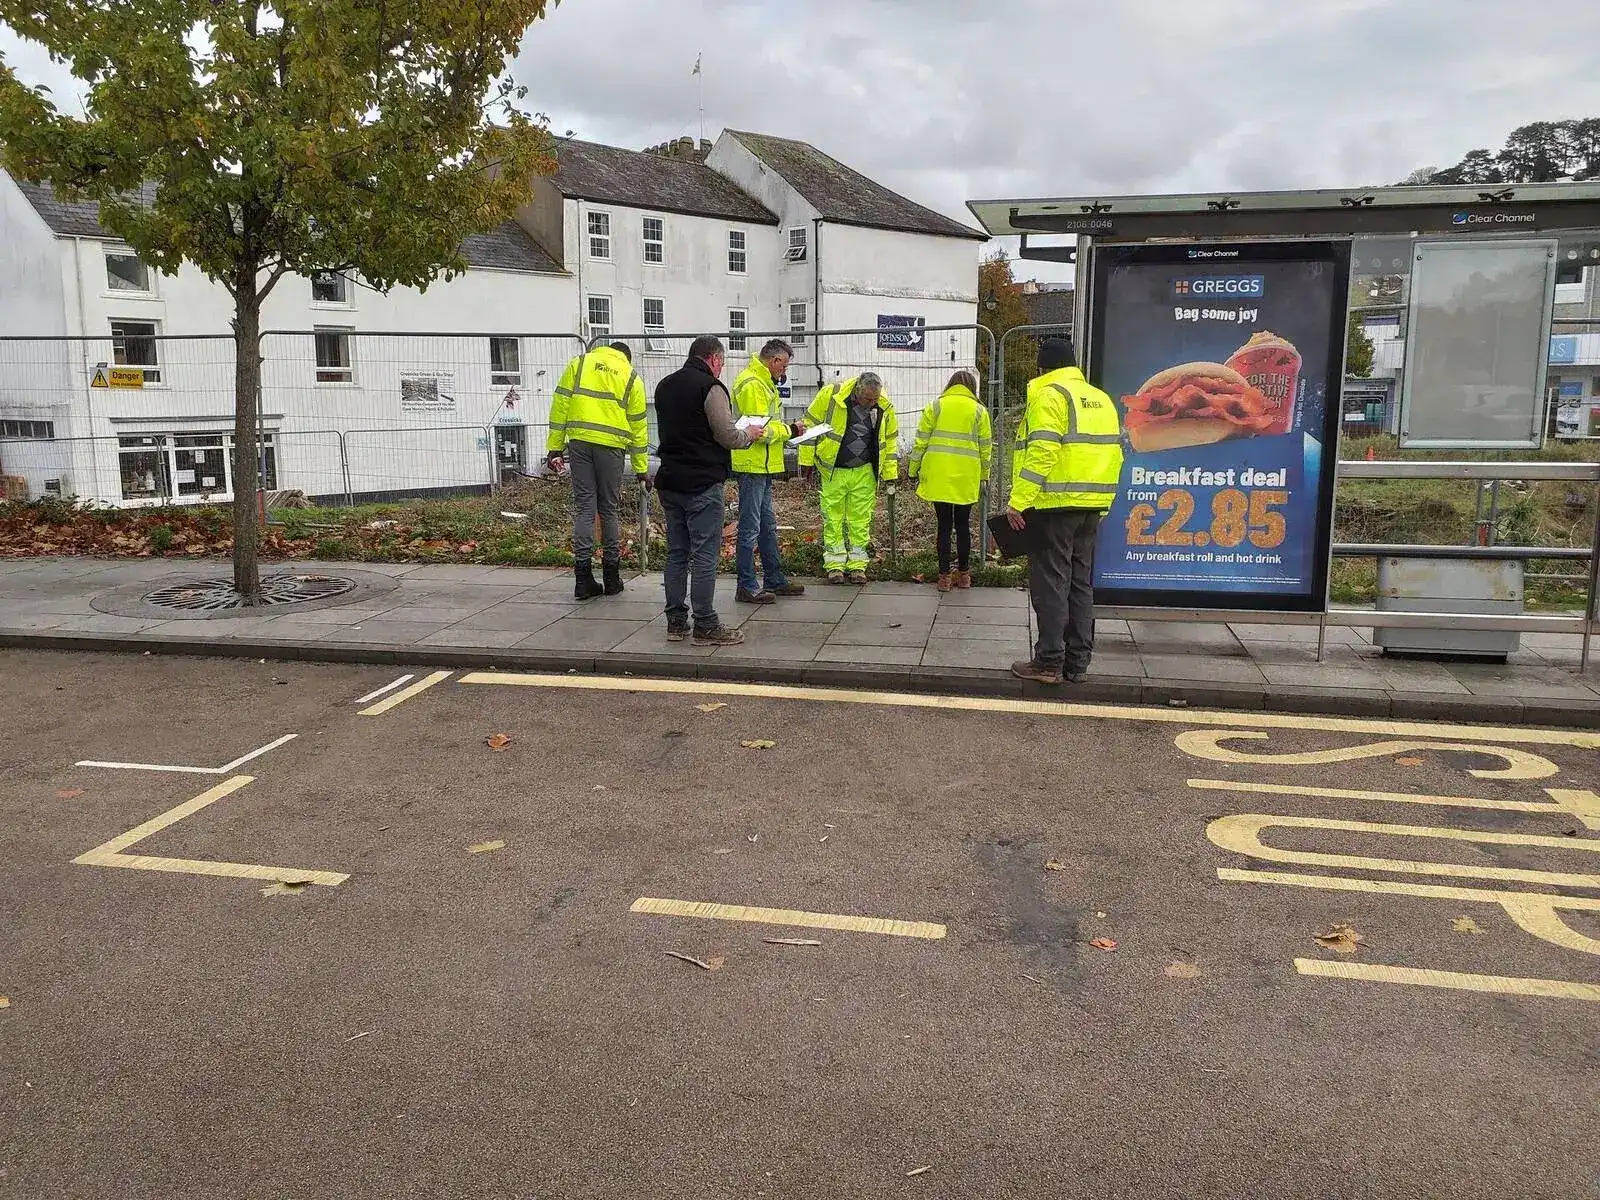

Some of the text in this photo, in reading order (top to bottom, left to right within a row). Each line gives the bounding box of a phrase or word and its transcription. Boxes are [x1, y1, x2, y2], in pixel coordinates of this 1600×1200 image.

[1090, 219, 1113, 228] 0046
[1468, 212, 1535, 223] Clear Channel
[1197, 249, 1239, 258] Clear Channel
[1192, 279, 1260, 294] GREGGS
[1174, 306, 1258, 324] Bag some joy
[112, 371, 140, 382] Danger
[1247, 373, 1290, 386] OR THE
[1260, 384, 1290, 398] STIVE
[1131, 466, 1287, 487] Breakfast deal
[1127, 489, 1157, 501] from
[1124, 488, 1289, 549] £2.85
[1125, 551, 1283, 565] Any breakfast roll and hot drink
